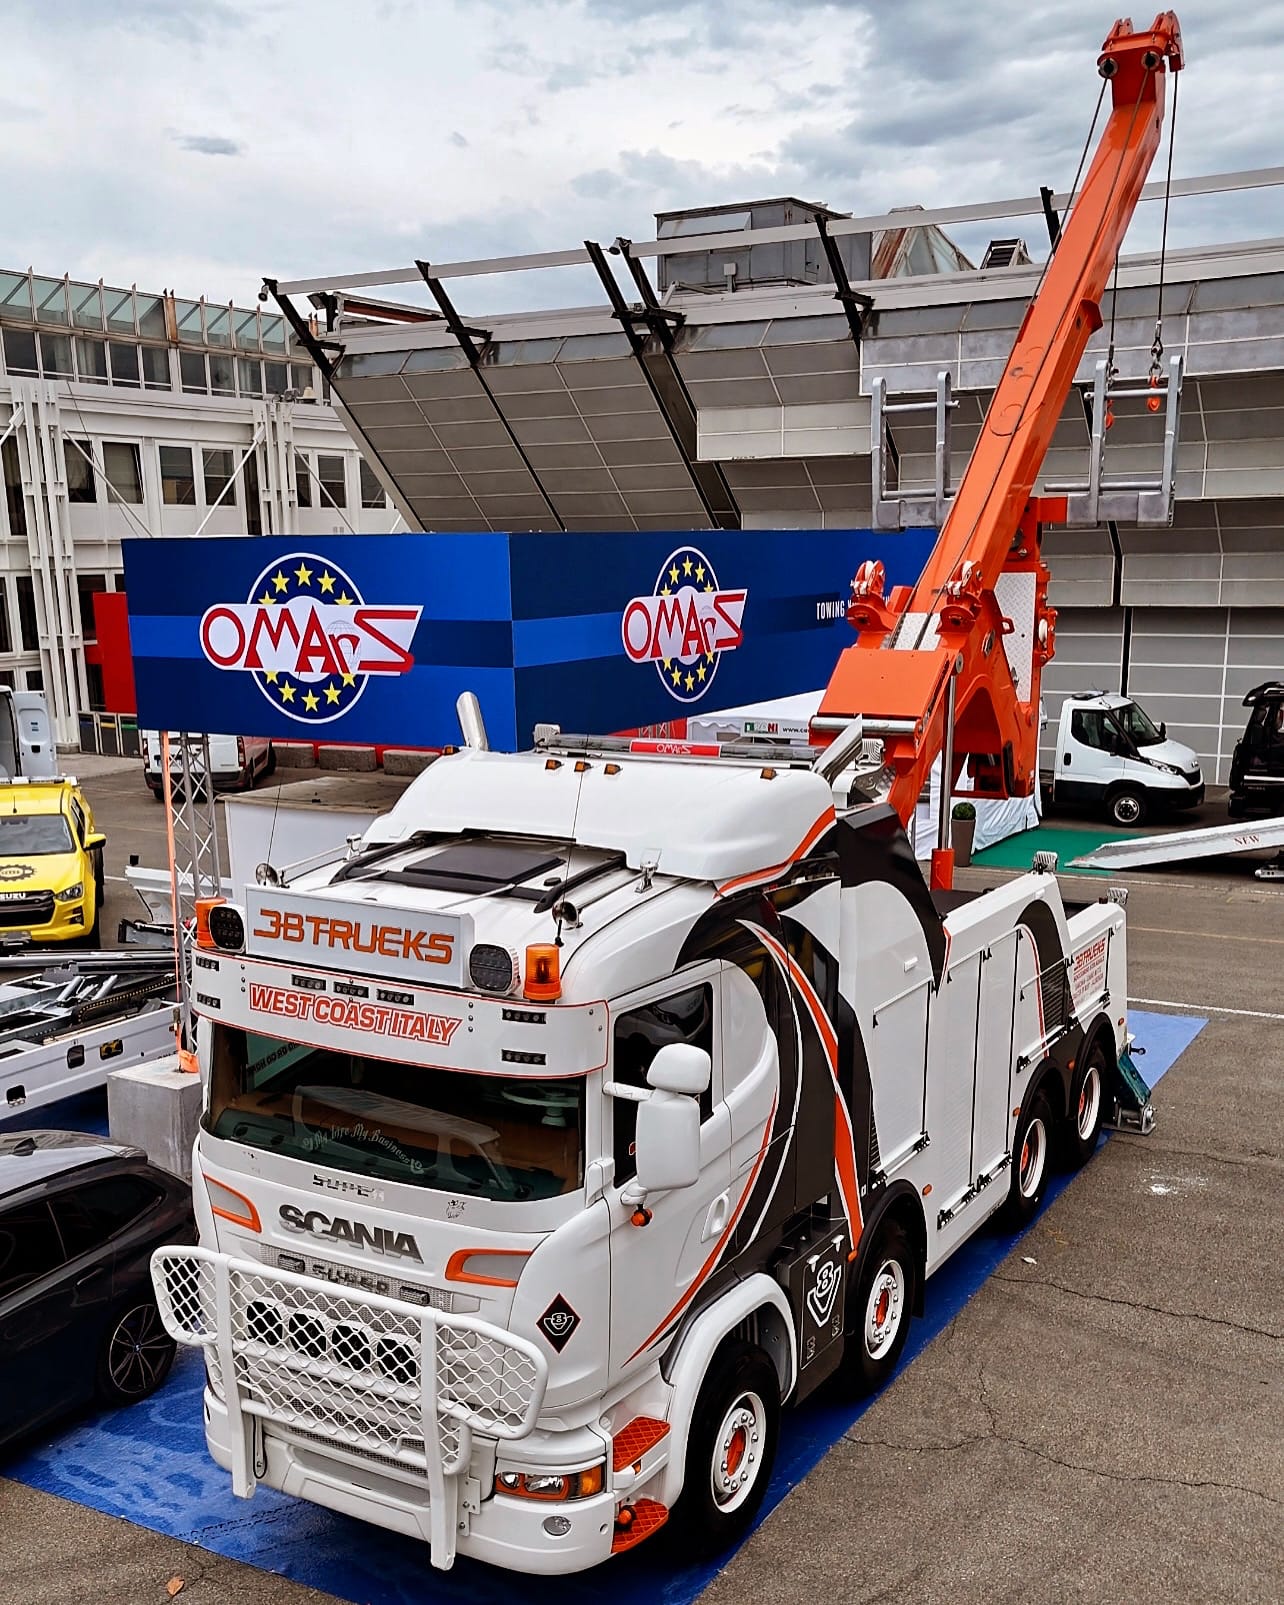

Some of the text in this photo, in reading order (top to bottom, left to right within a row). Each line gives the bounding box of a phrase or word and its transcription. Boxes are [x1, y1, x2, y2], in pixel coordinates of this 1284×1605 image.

[816, 600, 845, 620] TOWING
[1233, 834, 1260, 846] NEW
[250, 984, 462, 1046] WEST COAST ITALY
[352, 1123, 369, 1141] My
[279, 1204, 424, 1264] SCANIA
